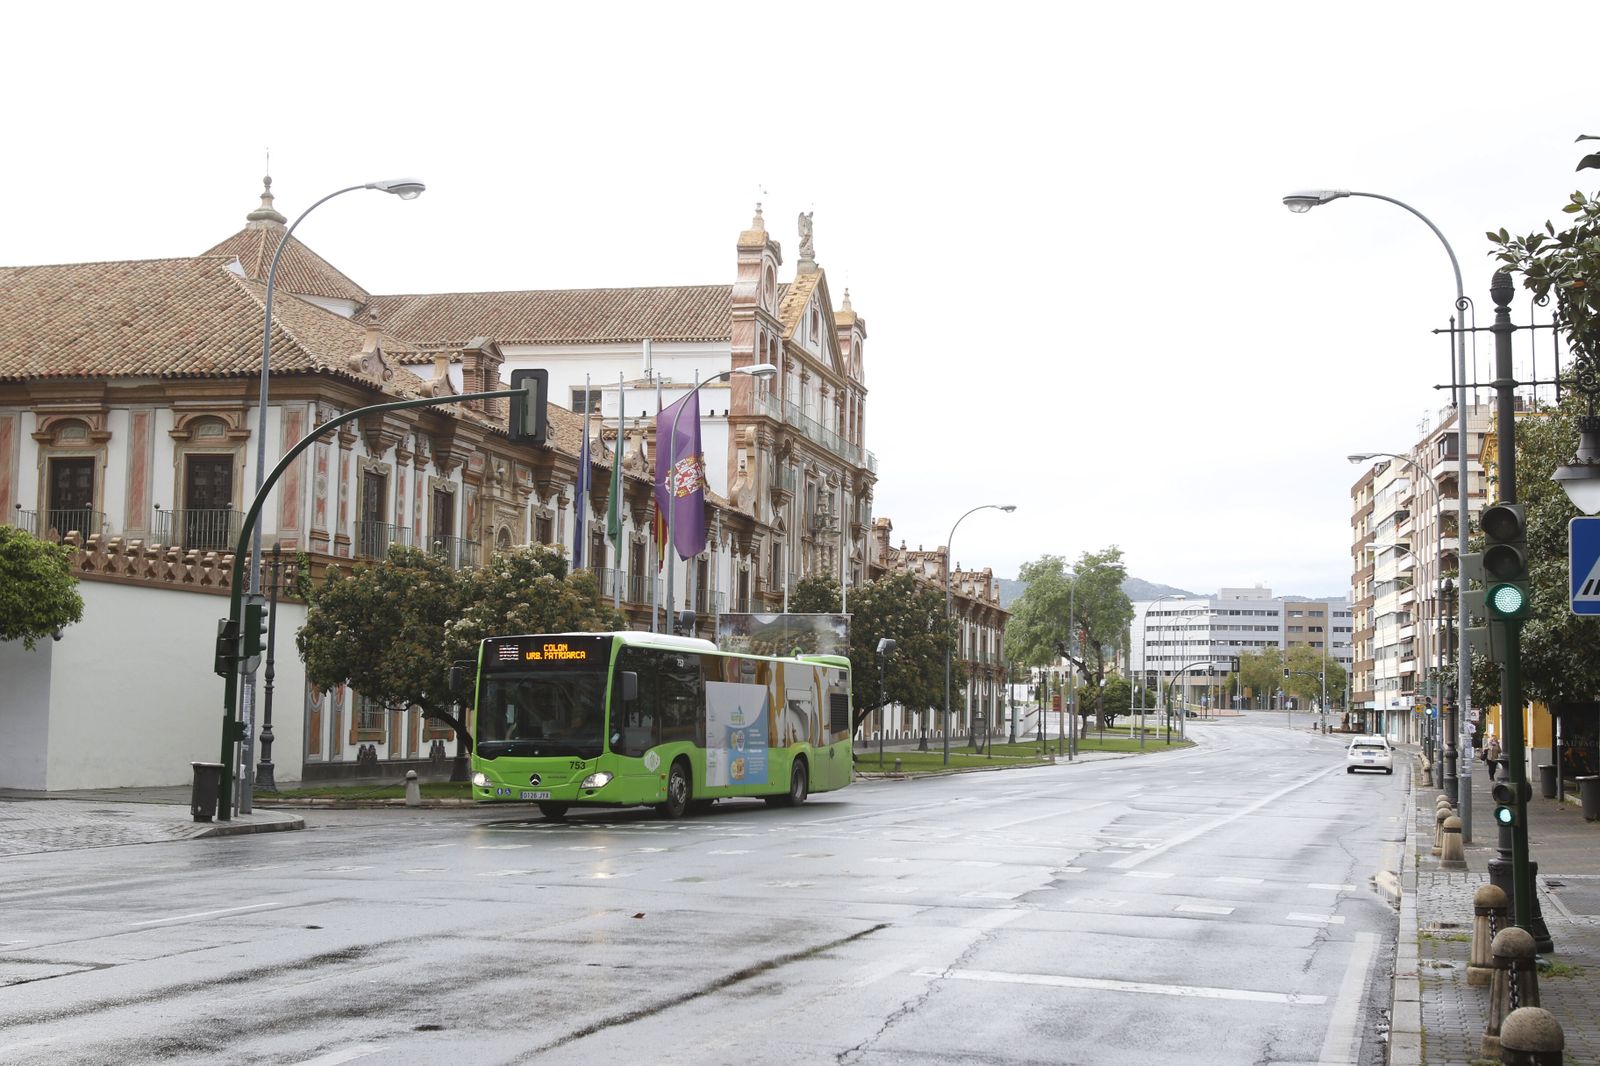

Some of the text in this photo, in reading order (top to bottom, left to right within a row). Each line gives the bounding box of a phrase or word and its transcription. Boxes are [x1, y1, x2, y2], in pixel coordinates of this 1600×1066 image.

[543, 643, 568, 651] COLON
[525, 651, 543, 660] URB.
[544, 651, 586, 660] PATRIARCA
[569, 761, 586, 770] 753
